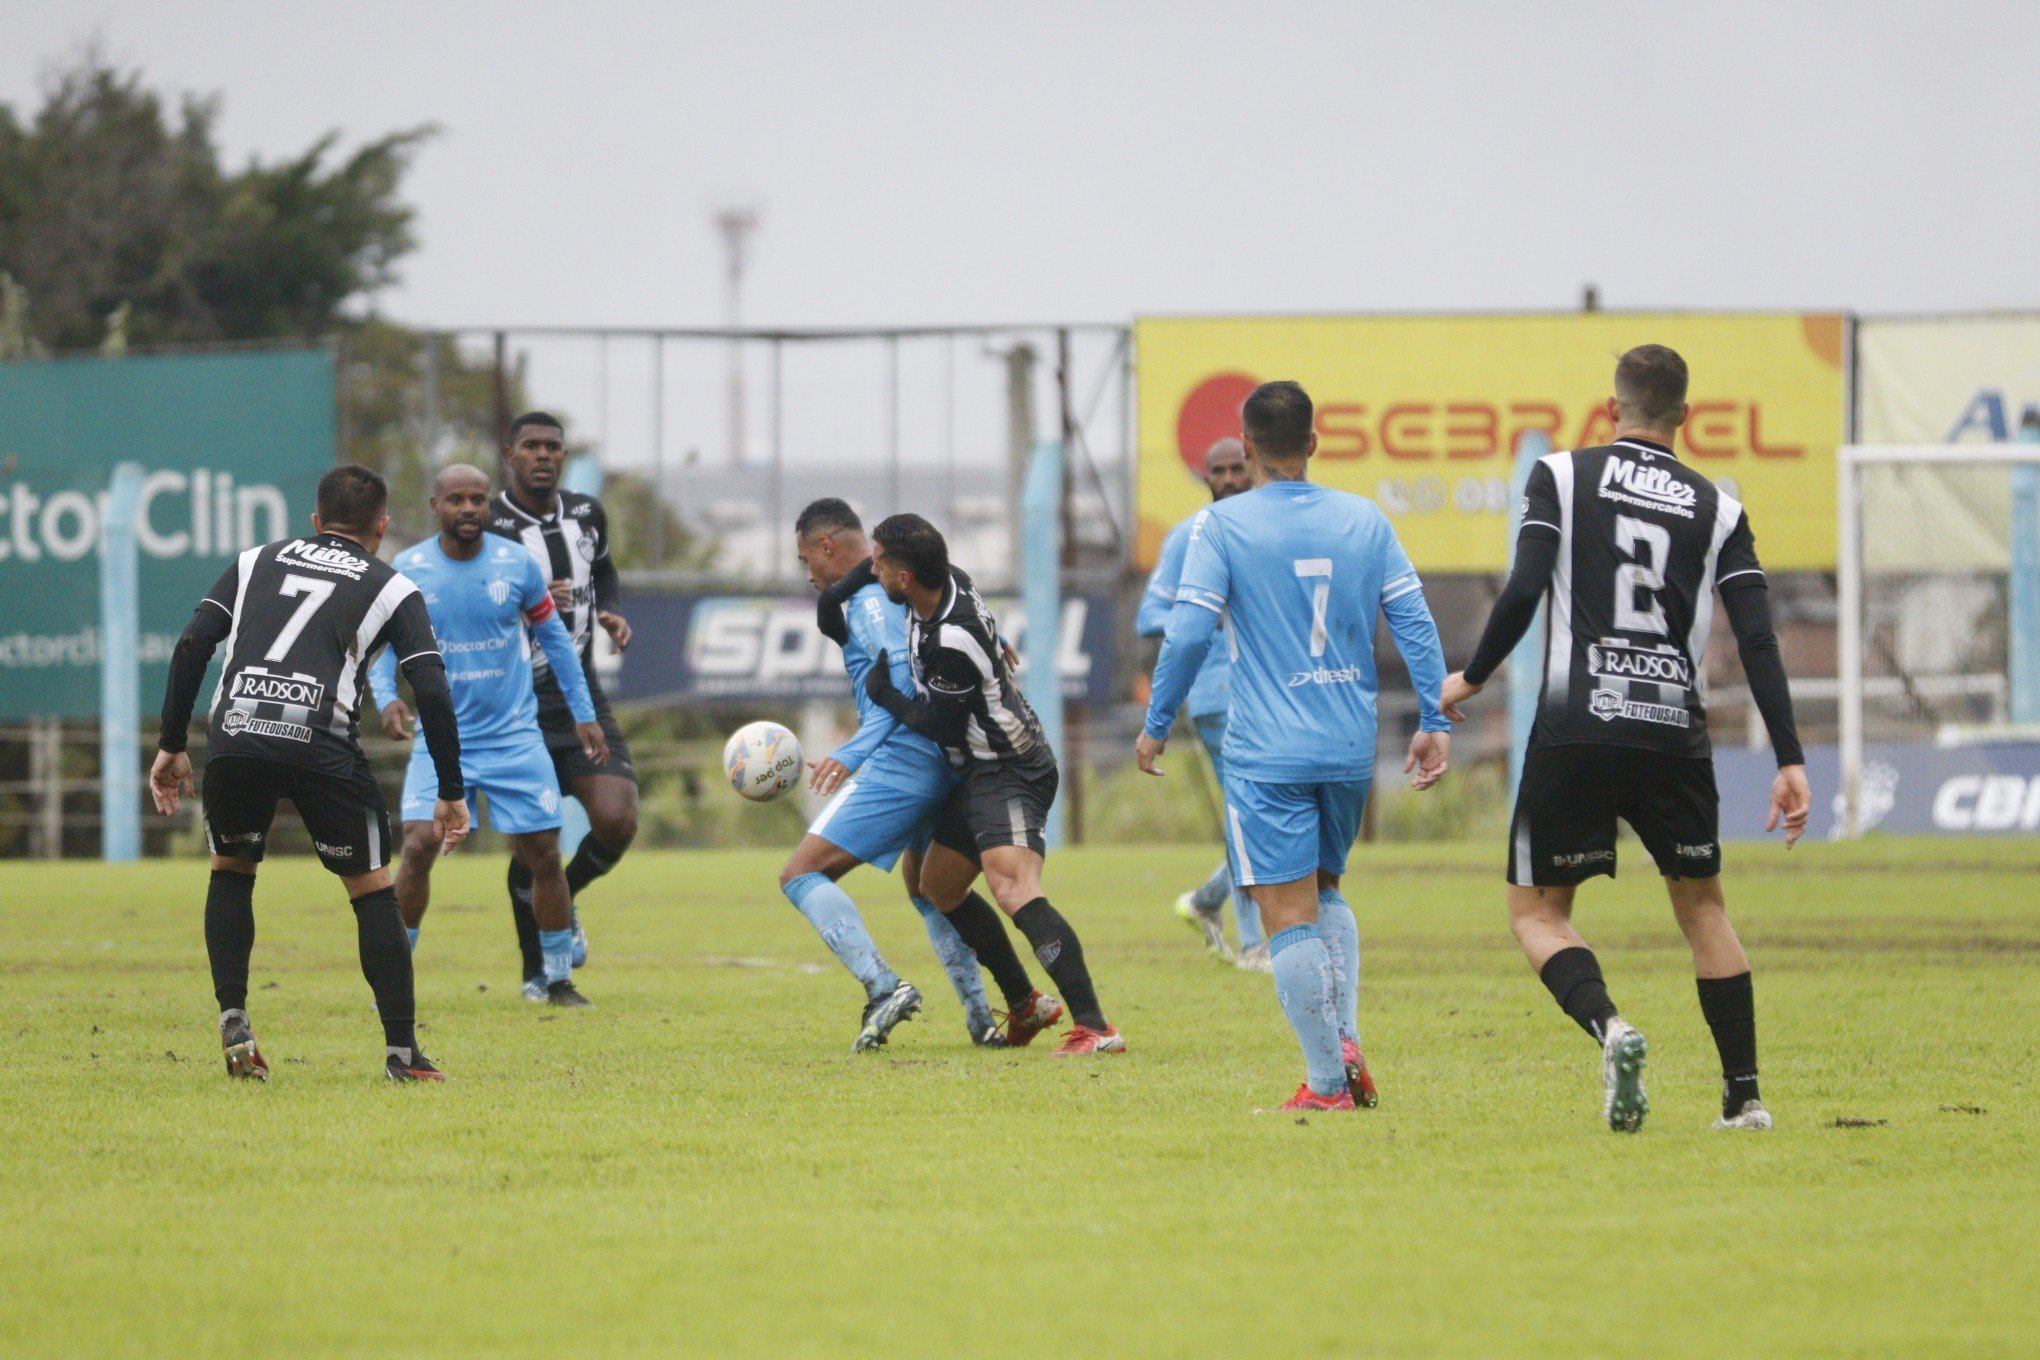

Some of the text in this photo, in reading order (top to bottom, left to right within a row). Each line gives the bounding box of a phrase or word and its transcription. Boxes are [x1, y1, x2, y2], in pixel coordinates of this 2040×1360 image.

[1312, 404, 1806, 462] SEBRAEL
[1600, 455, 1697, 504] Miller
[1598, 487, 1695, 519] Supermercados
[275, 553, 362, 581] Supermercados
[279, 539, 370, 573] Miller
[1614, 514, 1672, 637] 2
[263, 573, 337, 663] 7
[1293, 558, 1333, 657] 7
[1606, 651, 1689, 683] RADSON
[242, 677, 319, 705] RADSON
[248, 719, 311, 741] FUTEOUSADIA
[1625, 703, 1689, 726] FUTEOUSADIA
[315, 841, 353, 857] UNISC
